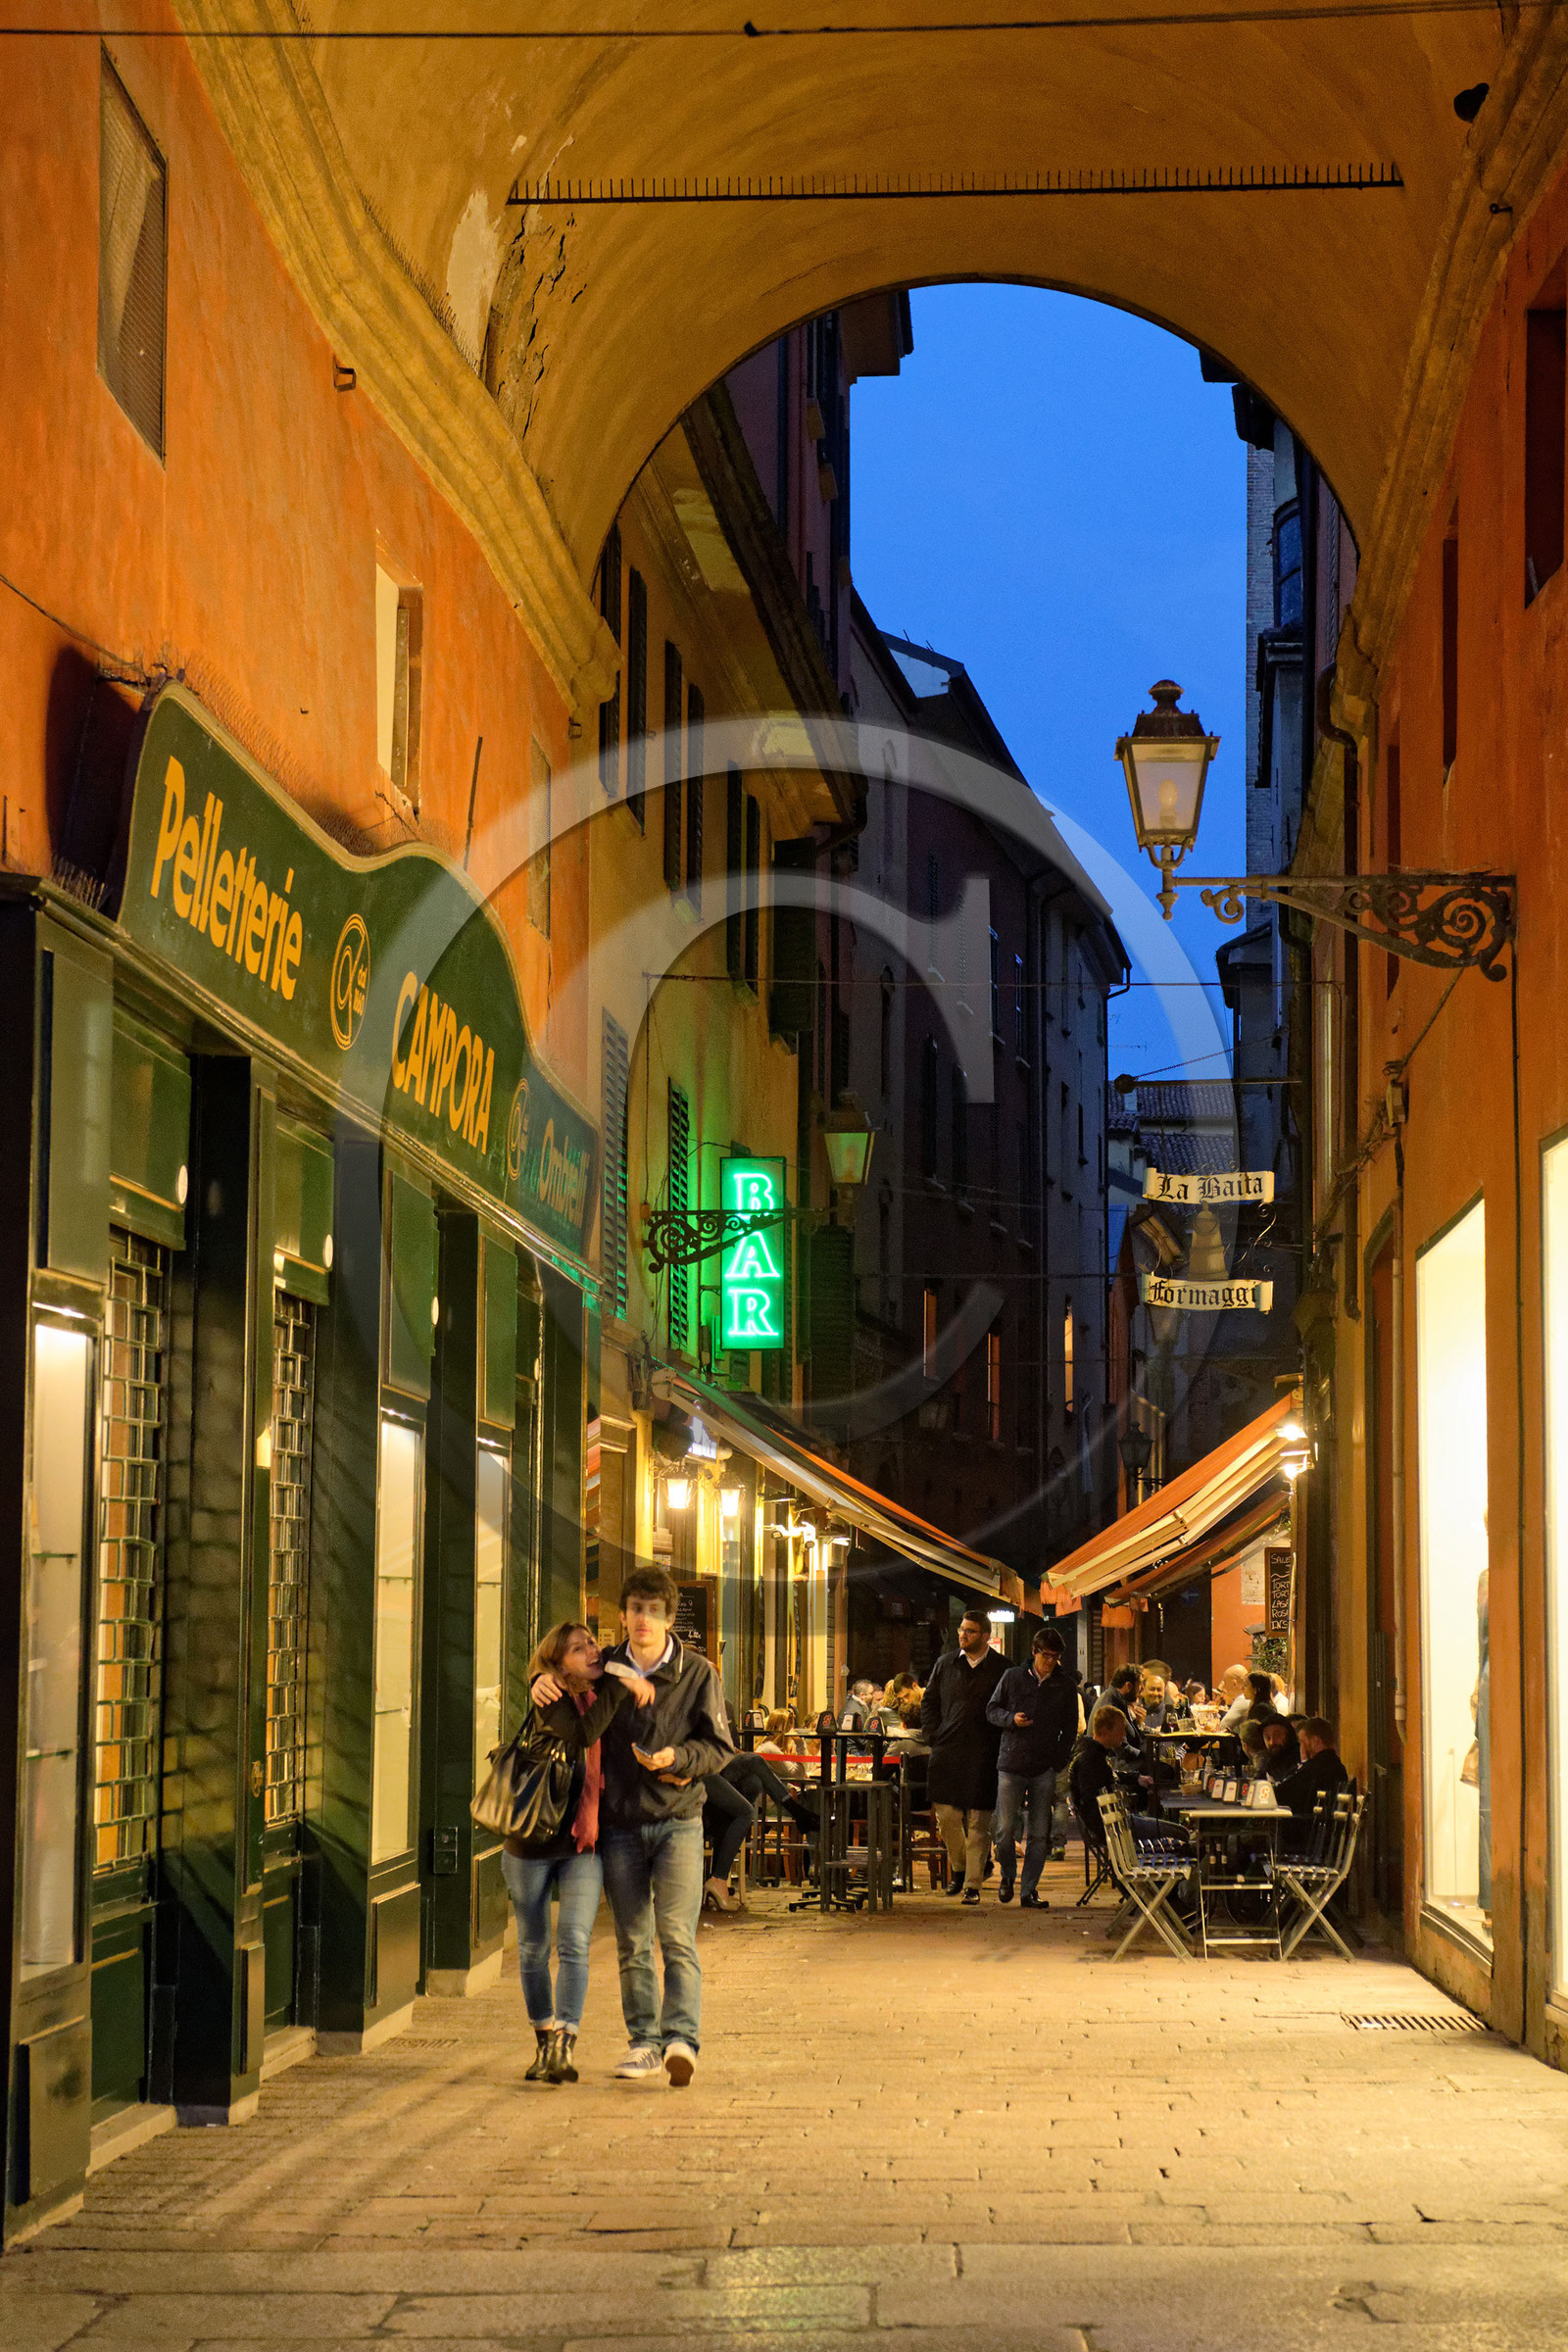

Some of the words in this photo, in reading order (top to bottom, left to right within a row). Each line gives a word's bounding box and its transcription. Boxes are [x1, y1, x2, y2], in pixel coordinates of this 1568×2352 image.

[151, 756, 303, 1001] Pelletterie
[391, 971, 496, 1155] CAMPORA
[724, 1172, 781, 1336] BAR
[1156, 1176, 1189, 1200] La
[1197, 1175, 1263, 1201] Baita
[1147, 1280, 1258, 1307] Formaggi
